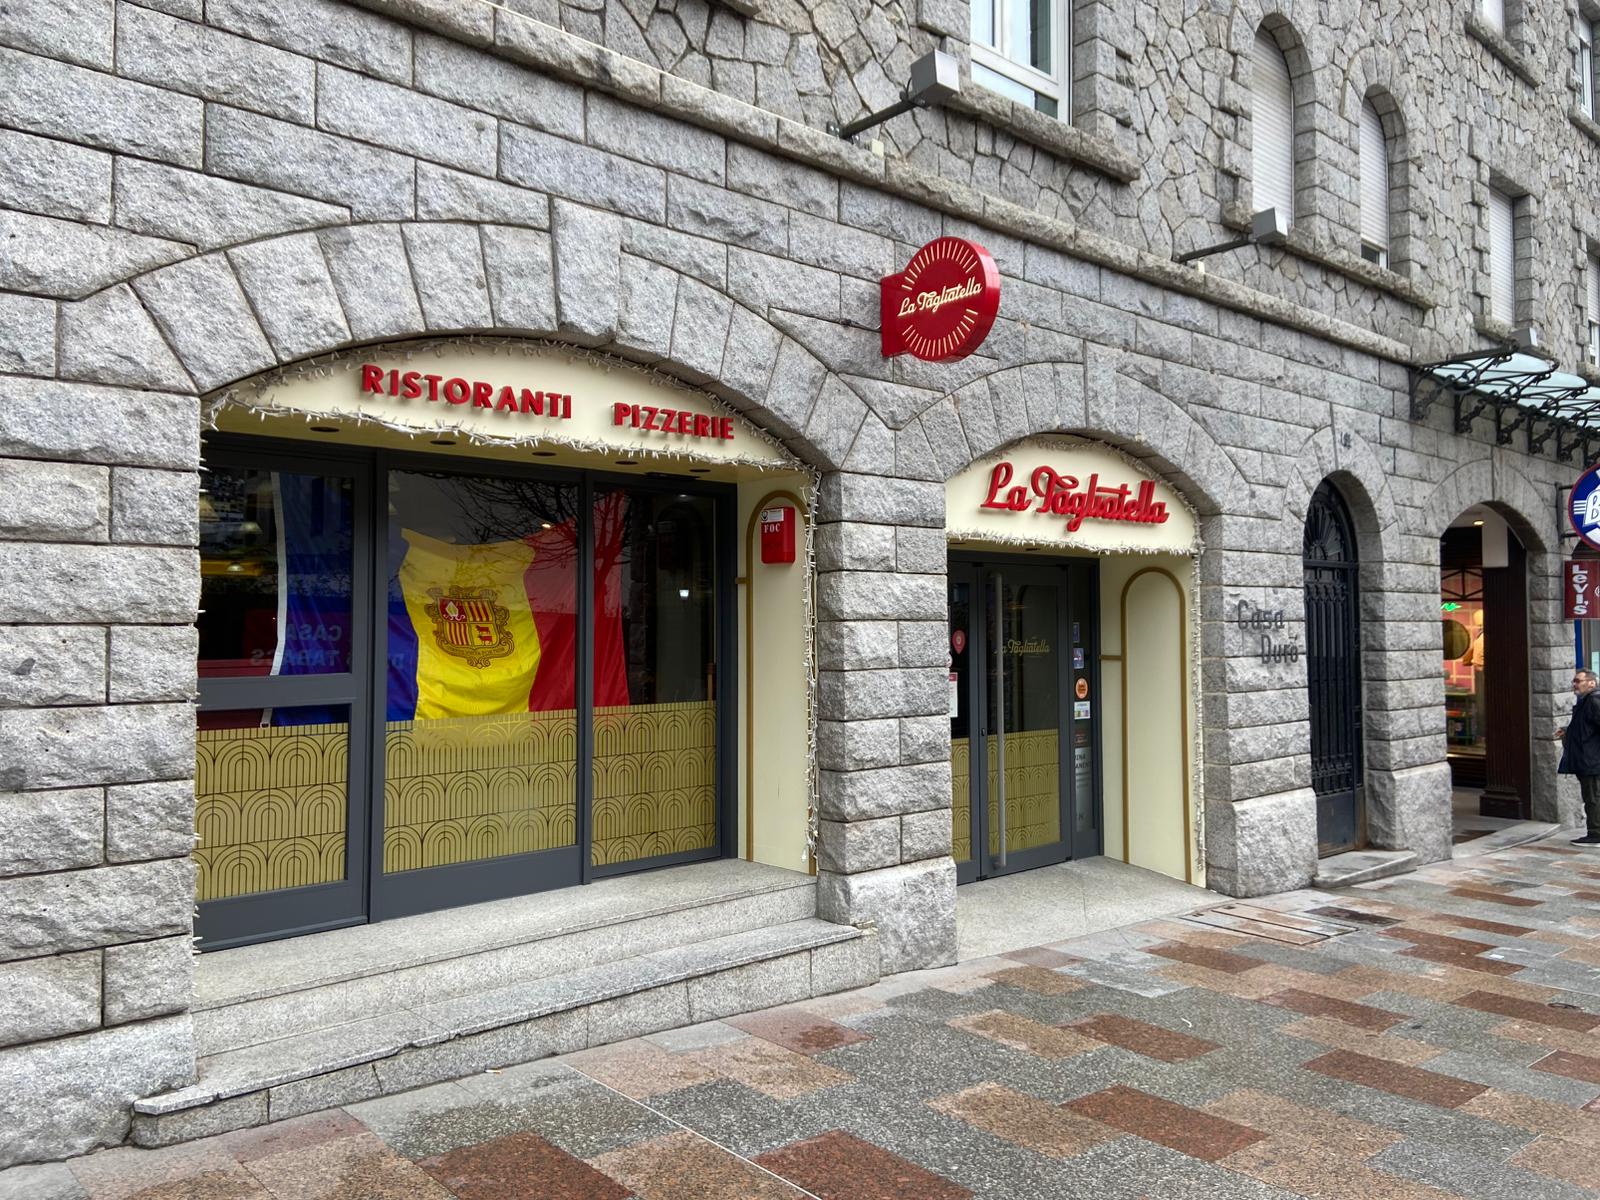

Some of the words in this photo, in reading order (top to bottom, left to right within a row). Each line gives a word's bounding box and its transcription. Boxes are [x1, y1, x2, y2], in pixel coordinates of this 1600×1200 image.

[897, 297, 917, 317] La
[917, 276, 983, 313] Tagliatella
[361, 364, 572, 419] RISTORANTI
[613, 402, 735, 439] PIZZERIE
[980, 462, 1033, 512] La
[1031, 465, 1170, 532] Tagliatella
[764, 523, 781, 533] FOC
[1238, 600, 1285, 630] Casa
